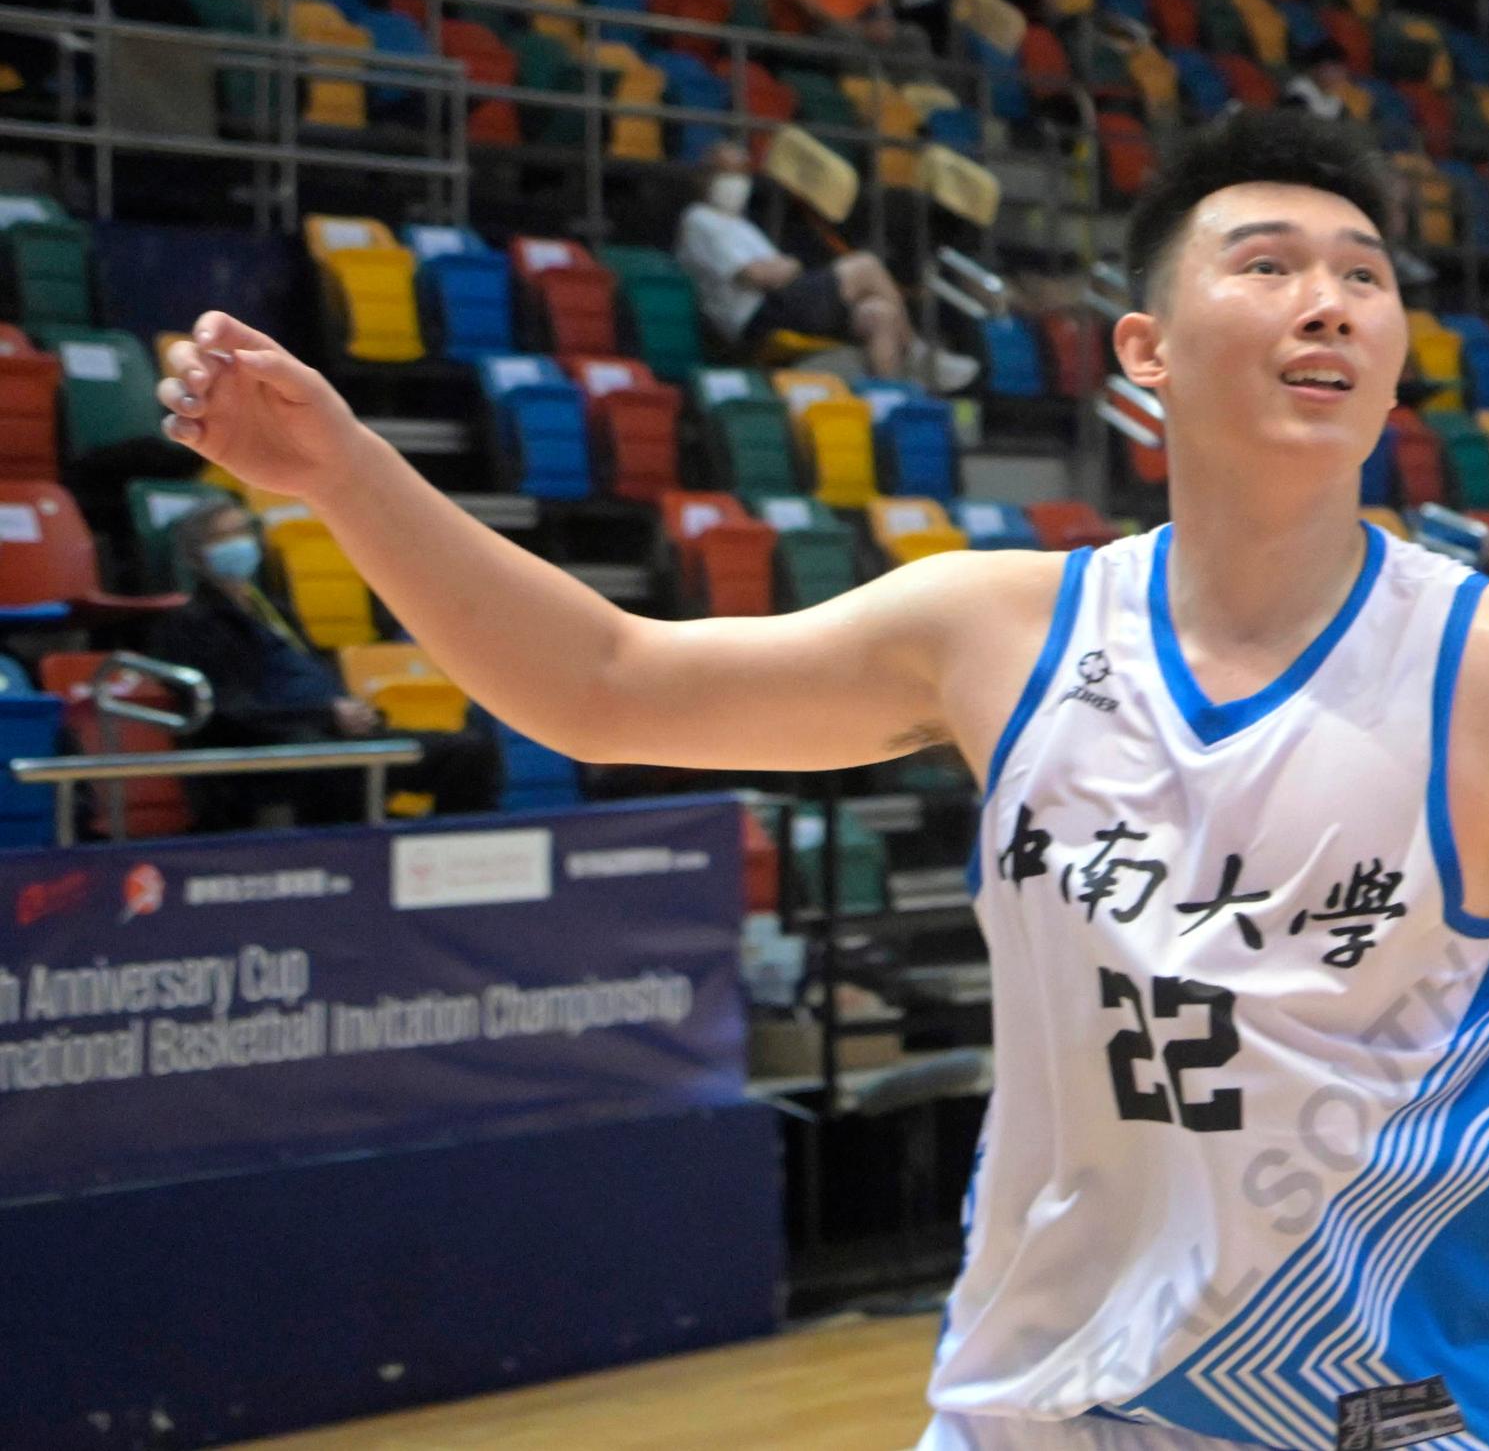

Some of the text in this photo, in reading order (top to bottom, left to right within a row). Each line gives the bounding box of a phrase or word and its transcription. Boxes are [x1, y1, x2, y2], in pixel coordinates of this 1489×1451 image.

[25, 955, 236, 1022] Anniversary
[238, 944, 309, 1006] Cup
[150, 999, 328, 1077] Basketball
[330, 988, 479, 1055] Invitation
[481, 967, 694, 1038] Championship
[1098, 966, 1243, 1133] 22
